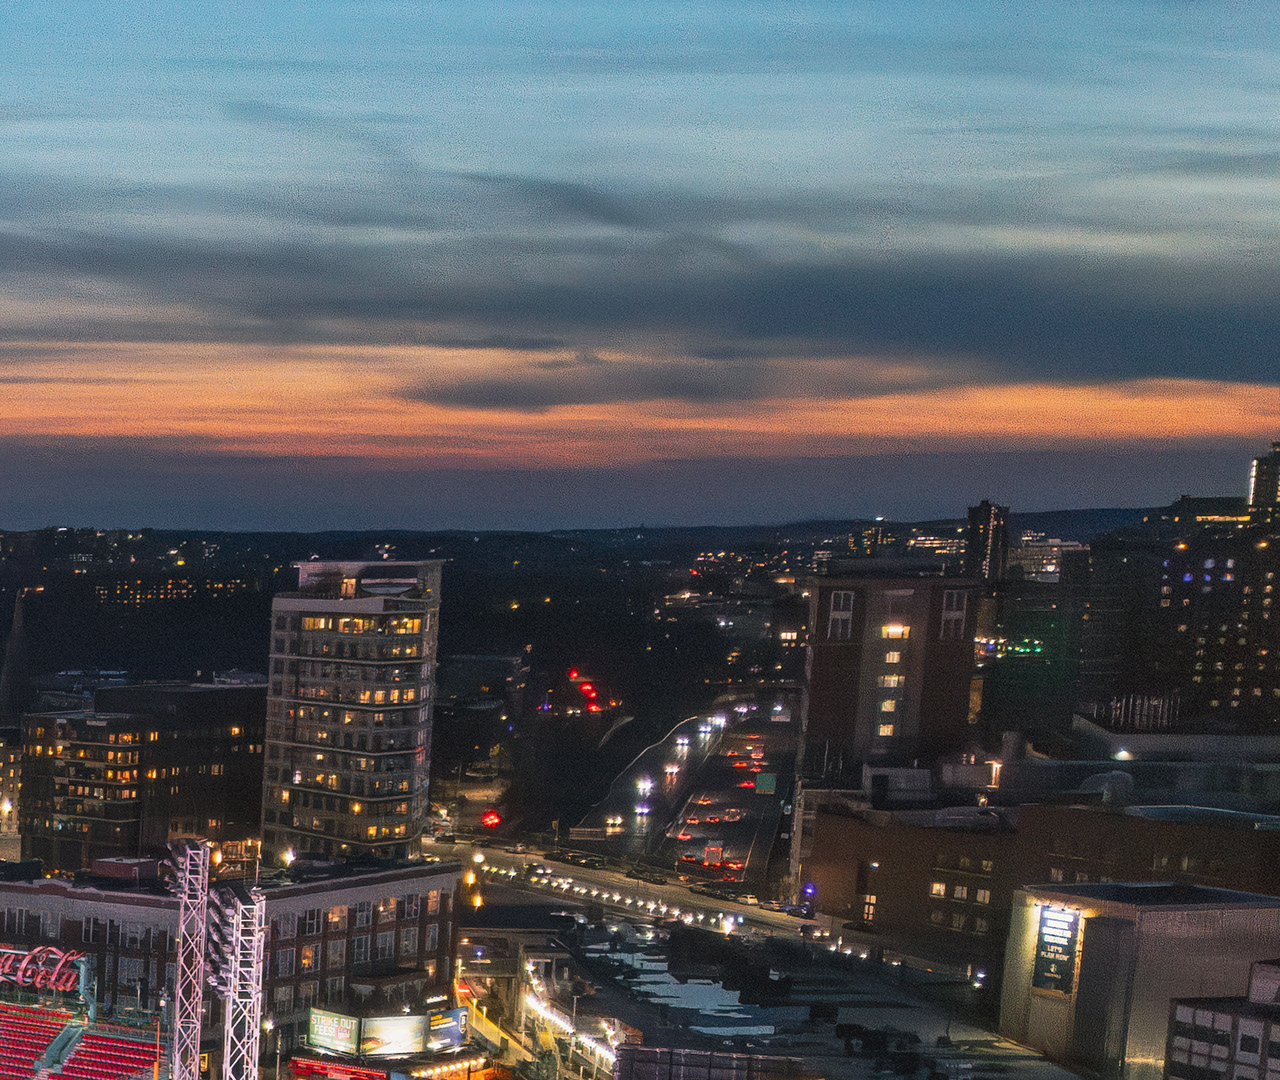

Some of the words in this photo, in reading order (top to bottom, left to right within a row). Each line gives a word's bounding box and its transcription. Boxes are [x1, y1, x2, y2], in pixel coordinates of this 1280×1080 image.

[1040, 951, 1055, 959] PLAN
[312, 1014, 340, 1029] STRIKE
[341, 1018, 358, 1030] OUT
